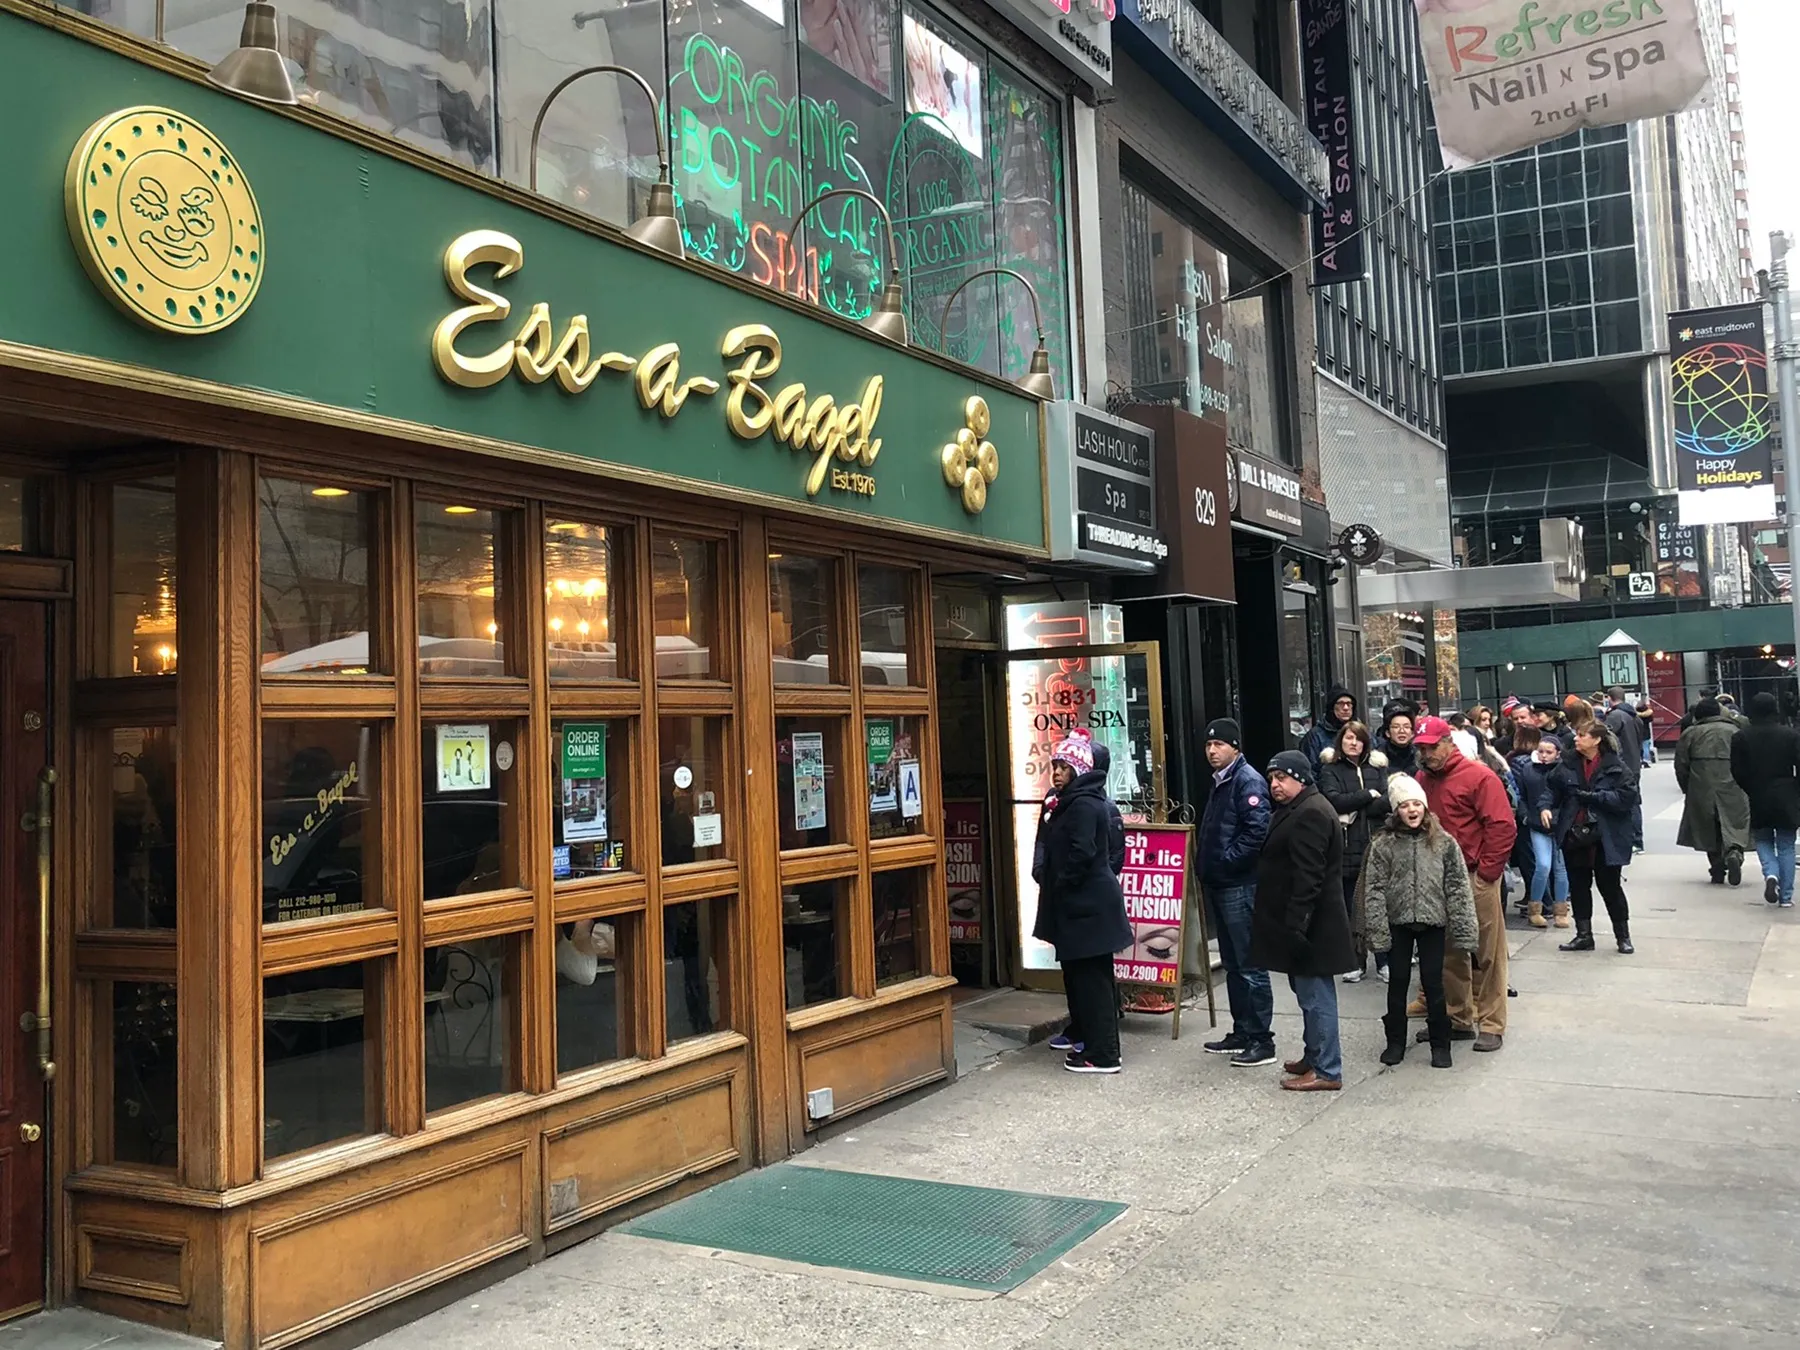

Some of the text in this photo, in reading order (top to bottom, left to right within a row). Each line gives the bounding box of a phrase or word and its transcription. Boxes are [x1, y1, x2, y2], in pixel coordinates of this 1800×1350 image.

[1445, 0, 1664, 73] Refresh
[1468, 63, 1548, 110] Nail
[1585, 40, 1667, 81] Spa
[684, 32, 860, 182] ORGANIC
[1531, 101, 1578, 126] 2nd
[1313, 57, 1338, 271] AIRBSH TAN
[1333, 95, 1353, 226] & SALON
[681, 106, 871, 256] BOTANICAL
[916, 177, 953, 216] 100%
[751, 221, 819, 306] SPA
[1694, 326, 1713, 336] east
[1714, 320, 1755, 333] midtown
[1205, 321, 1235, 367] Salon
[431, 228, 884, 497] Ess-a-Bagel
[1077, 426, 1139, 467] LASH HOLIC
[1695, 459, 1736, 472] Happy
[1696, 469, 1763, 485] Holidays
[1240, 461, 1300, 501] DILL & PARSLEY
[1105, 483, 1127, 513] Spa
[1195, 486, 1216, 527] 829
[1060, 687, 1097, 707] 831
[870, 726, 889, 737] ORDER
[1034, 709, 1126, 732] ONE SPA
[567, 731, 600, 744] ORDER
[870, 736, 890, 747] ONLINE
[567, 744, 600, 757] ONLINE
[905, 770, 918, 801] A
[553, 847, 570, 858] AGAT
[1125, 832, 1148, 848] sh
[553, 857, 570, 866] ATED
[1118, 873, 1174, 897] YELASH
[279, 897, 294, 909] CALL
[279, 909, 291, 922] FOR
[292, 906, 322, 920] CATERING
[332, 901, 365, 915] DELIVERIES
[1125, 896, 1183, 921] ENSION
